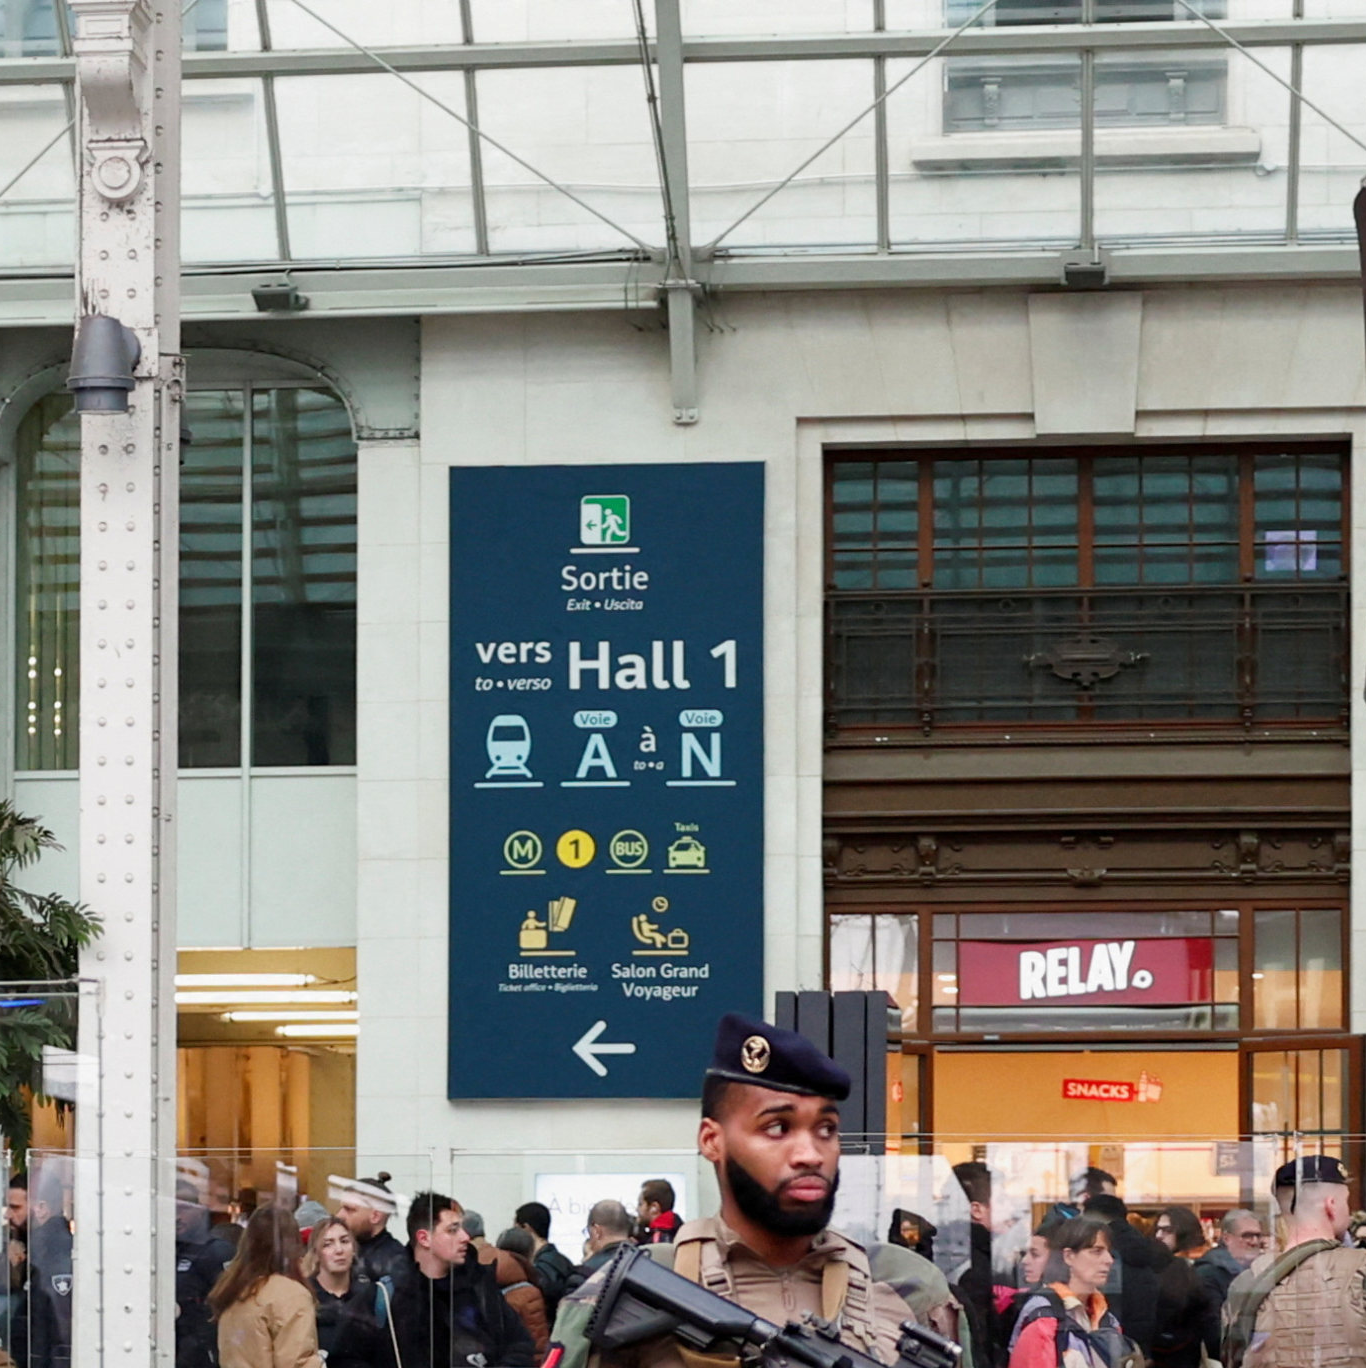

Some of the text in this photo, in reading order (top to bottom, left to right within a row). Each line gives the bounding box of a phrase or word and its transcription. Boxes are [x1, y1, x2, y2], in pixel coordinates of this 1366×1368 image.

[561, 564, 649, 591] Sortie
[566, 599, 644, 611] Exit Uscita
[475, 640, 736, 690] vers Hall 1
[475, 677, 552, 691] to verso
[579, 714, 611, 726] Voie
[685, 712, 717, 725] Voie
[575, 726, 721, 778] A à N
[633, 760, 646, 771] to
[674, 822, 699, 832] Taxis
[513, 839, 533, 860] M
[569, 839, 580, 859] 1
[615, 841, 643, 856] BUS
[508, 963, 588, 979] Billetterie
[611, 963, 710, 979] Salon Grand
[1019, 940, 1135, 1000] RELAY
[498, 983, 599, 993] Ticket office Biglietteria
[622, 982, 699, 1001] Voyageur
[1066, 1082, 1130, 1098] SNACKS
